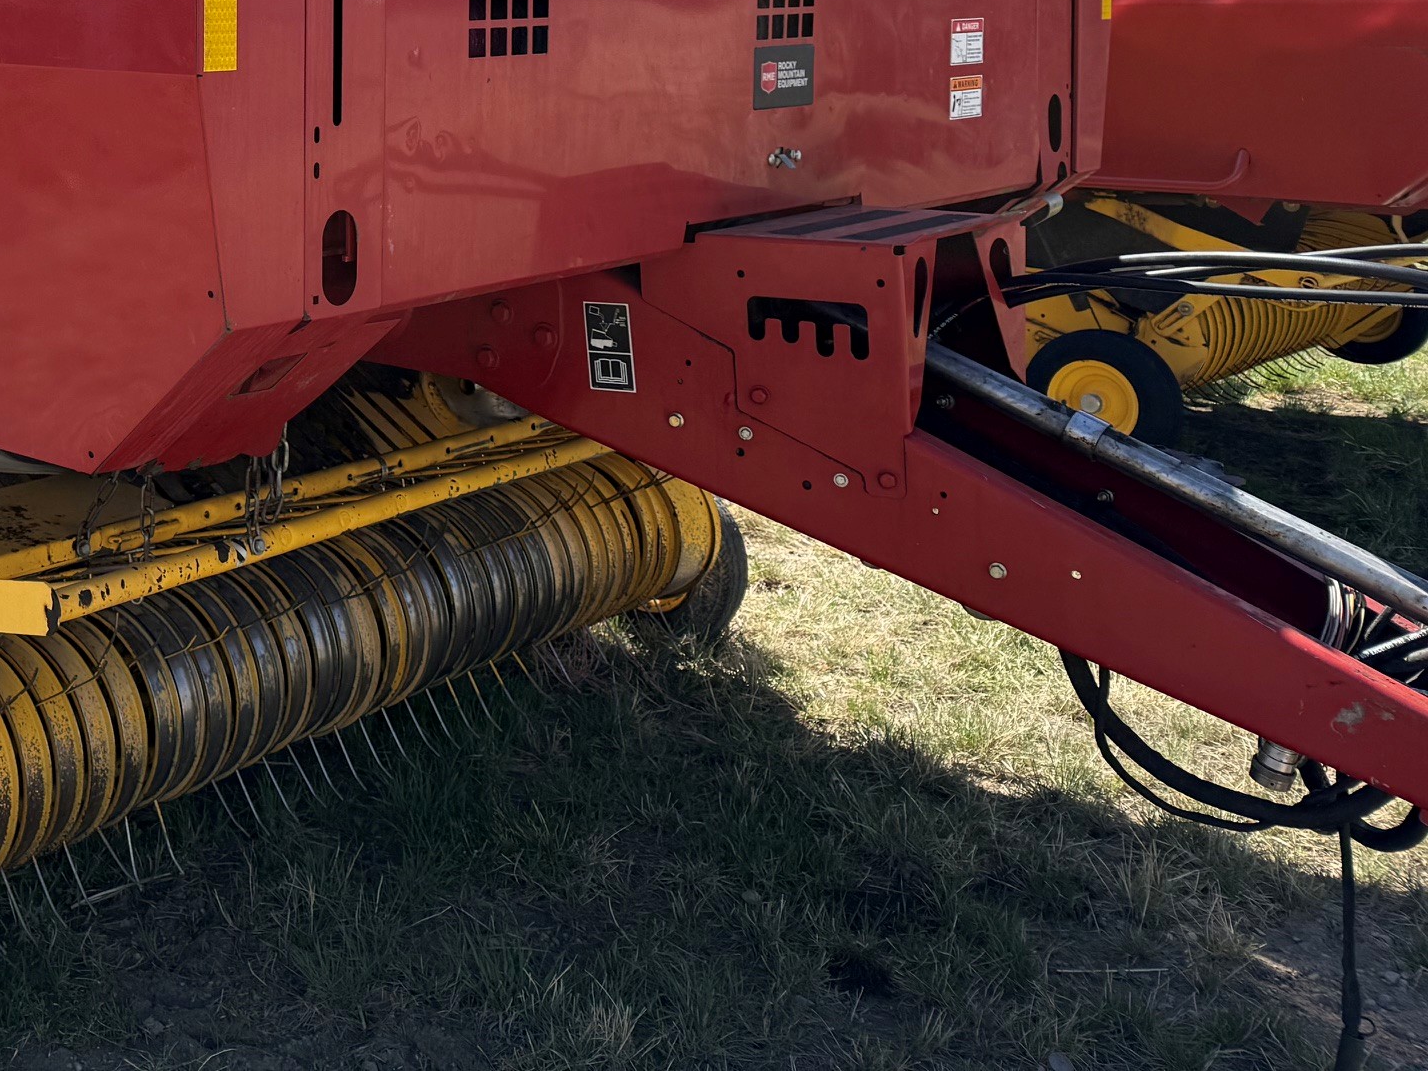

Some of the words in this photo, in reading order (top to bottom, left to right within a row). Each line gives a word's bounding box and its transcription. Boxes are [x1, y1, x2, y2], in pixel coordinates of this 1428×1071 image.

[962, 22, 979, 30] DANGER
[778, 61, 797, 70] ROCKY
[762, 72, 776, 82] RME
[778, 69, 805, 79] MOUNTAIN
[778, 78, 808, 88] EQUIPMENT
[957, 79, 979, 88] WARNING
